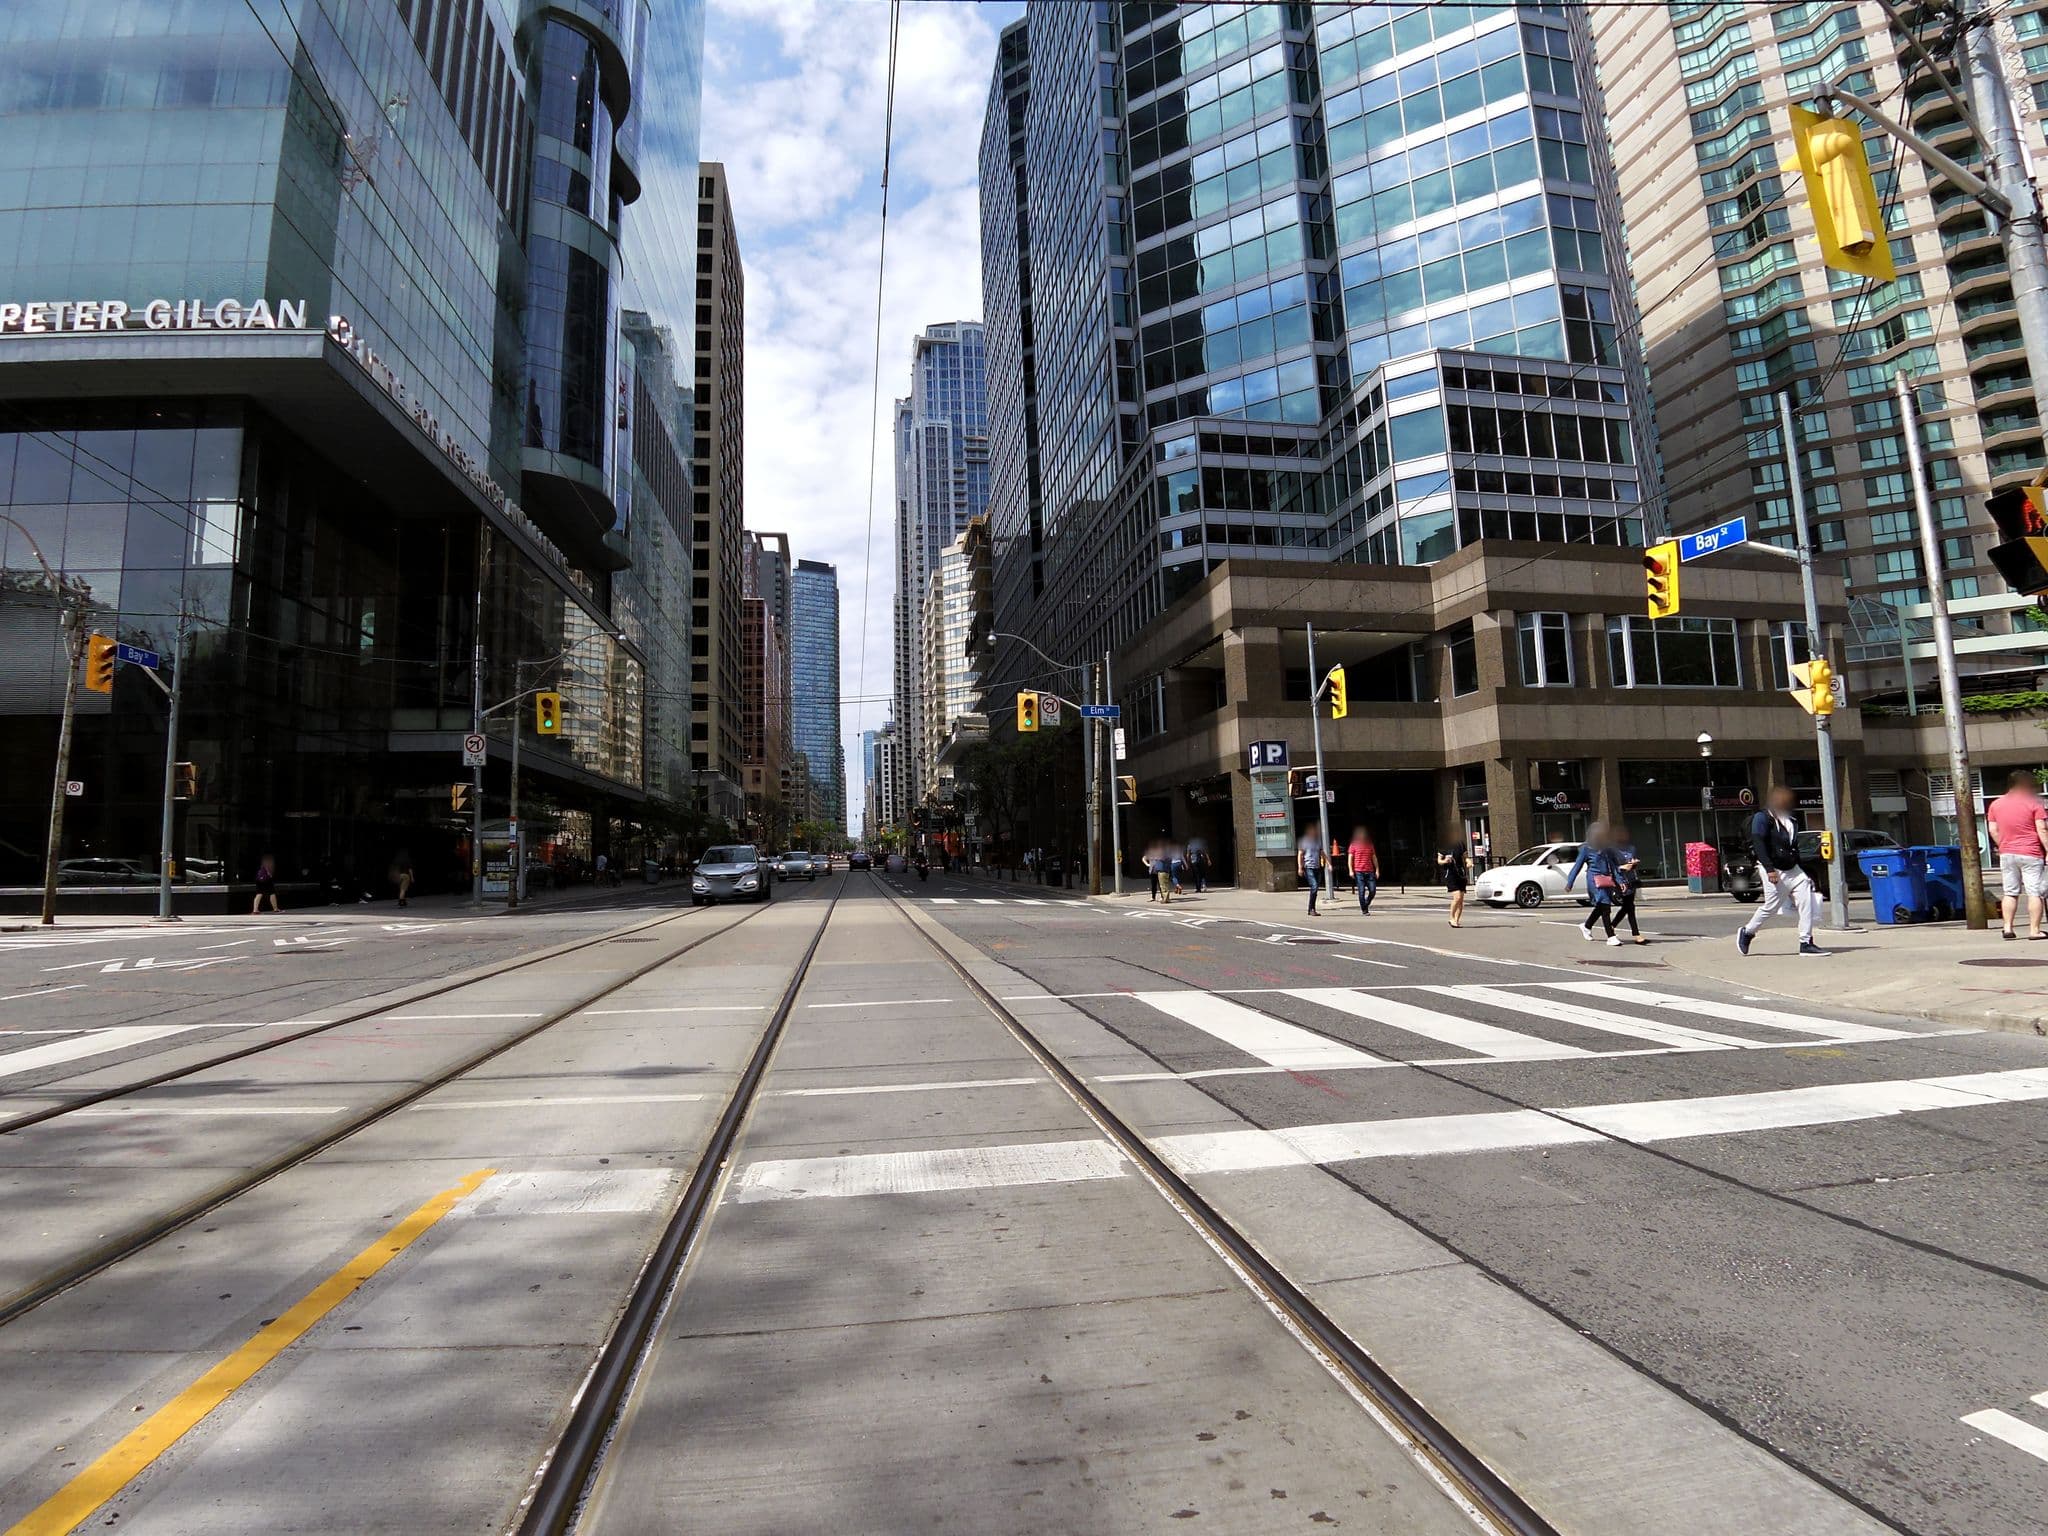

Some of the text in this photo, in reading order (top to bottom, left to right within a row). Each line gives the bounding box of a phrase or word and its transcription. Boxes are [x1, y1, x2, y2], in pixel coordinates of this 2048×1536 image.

[0, 299, 307, 333] PETER GILGAN
[1696, 527, 1728, 551] Bay St
[128, 648, 143, 664] Bay
[1090, 706, 1105, 715] Elm
[1251, 745, 1259, 765] P
[1266, 744, 1282, 763] P
